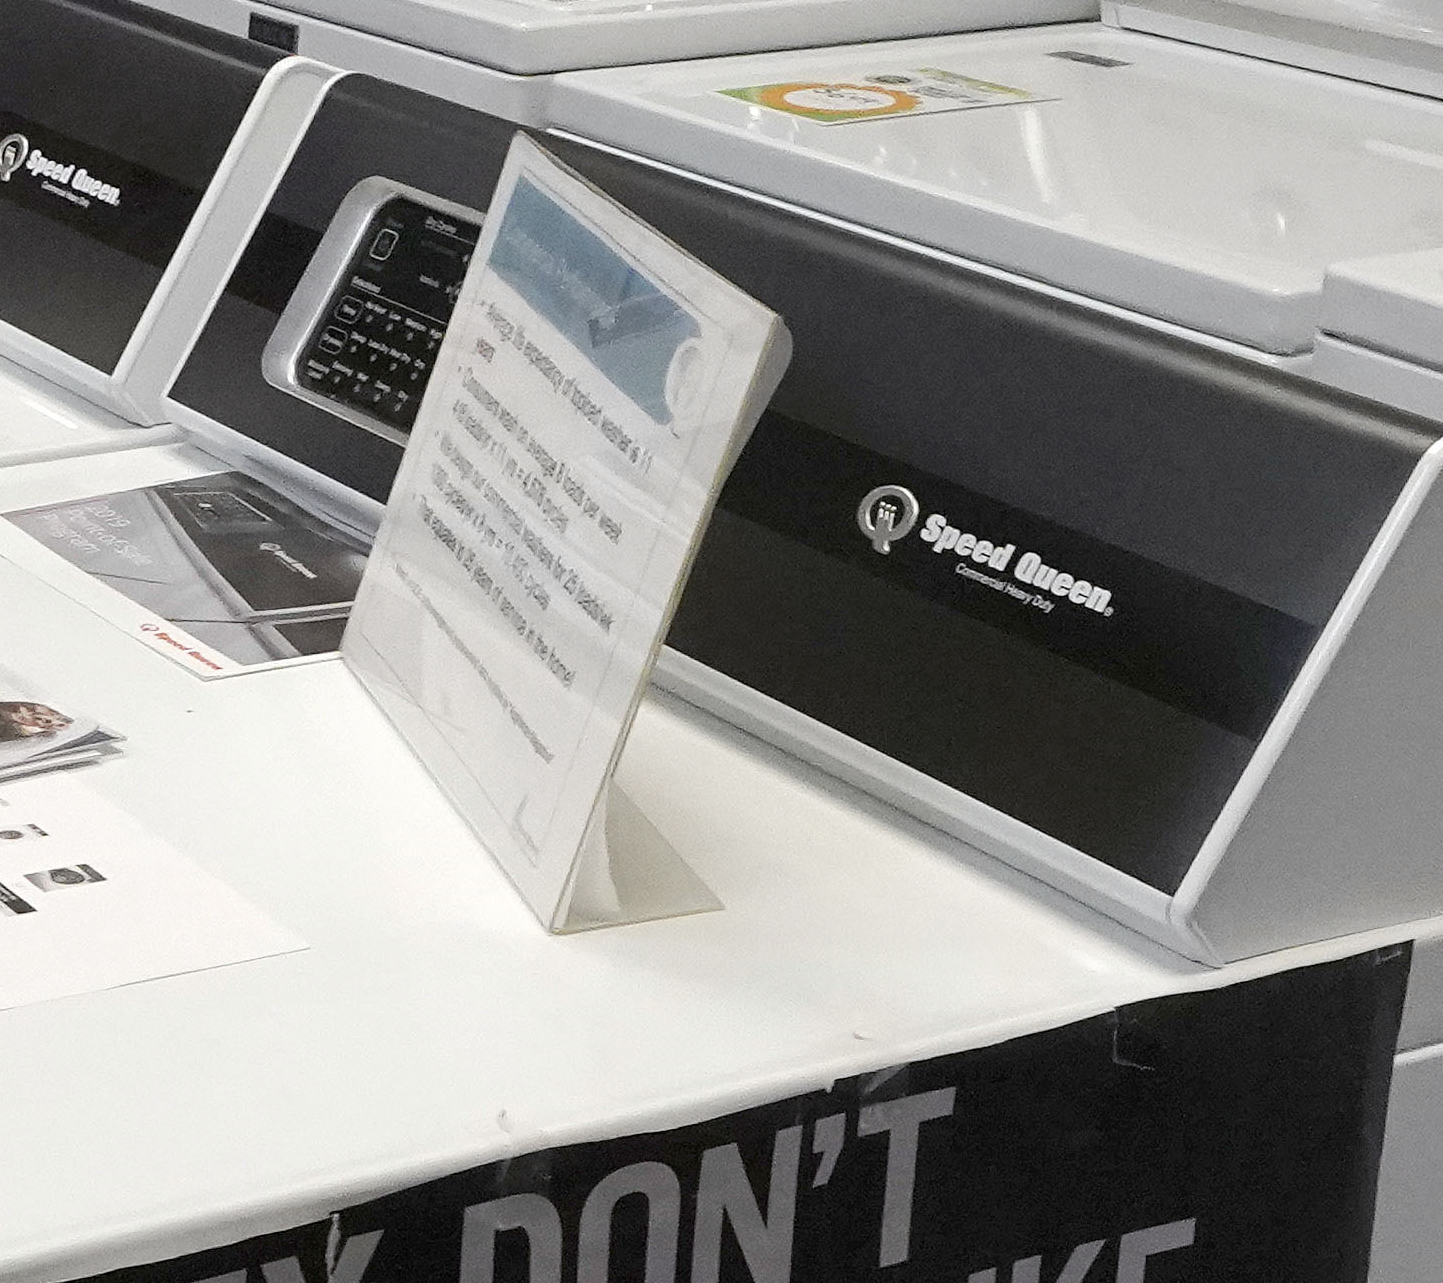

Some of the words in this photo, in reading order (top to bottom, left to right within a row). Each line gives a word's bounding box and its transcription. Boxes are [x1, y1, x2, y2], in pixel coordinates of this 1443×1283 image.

[26, 148, 71, 186] Speed
[69, 165, 120, 207] Queen
[919, 514, 1016, 573] Speed
[1014, 551, 1112, 615] Queen
